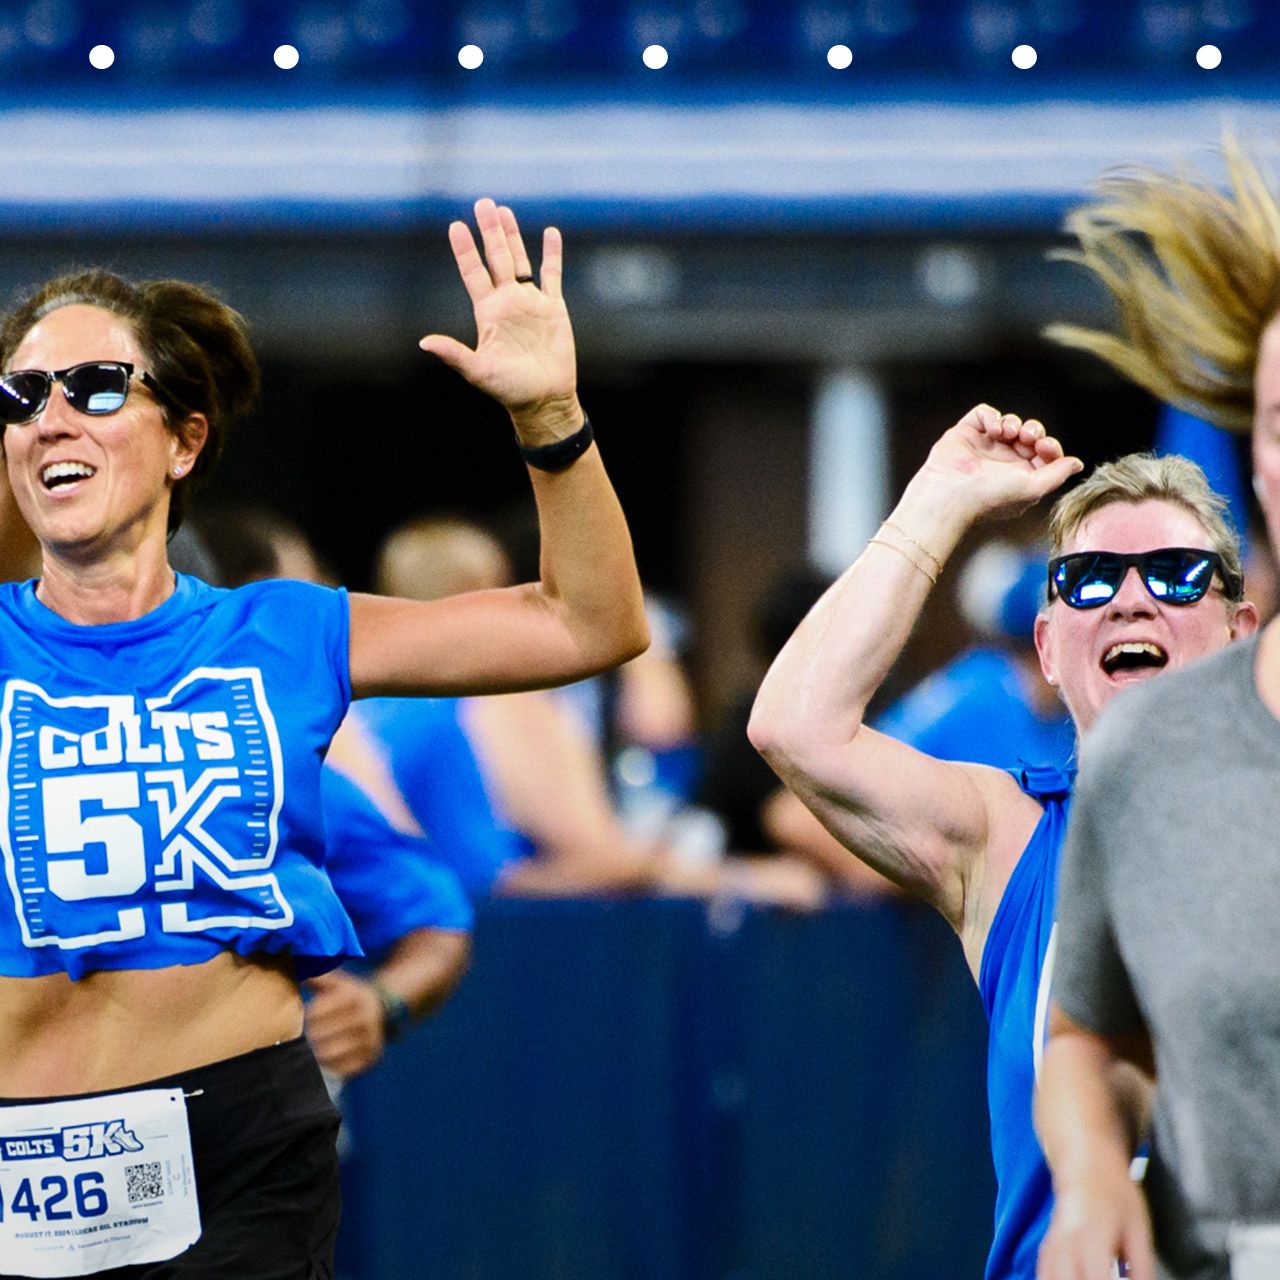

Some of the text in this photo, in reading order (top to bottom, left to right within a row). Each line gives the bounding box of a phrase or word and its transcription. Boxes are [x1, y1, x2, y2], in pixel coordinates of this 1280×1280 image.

[39, 710, 235, 770] COLTS
[41, 766, 242, 902] 5K
[5, 1119, 125, 1162] COLTS 5K
[99, 1223, 112, 1231] OIL
[113, 1217, 149, 1228] STADIUM
